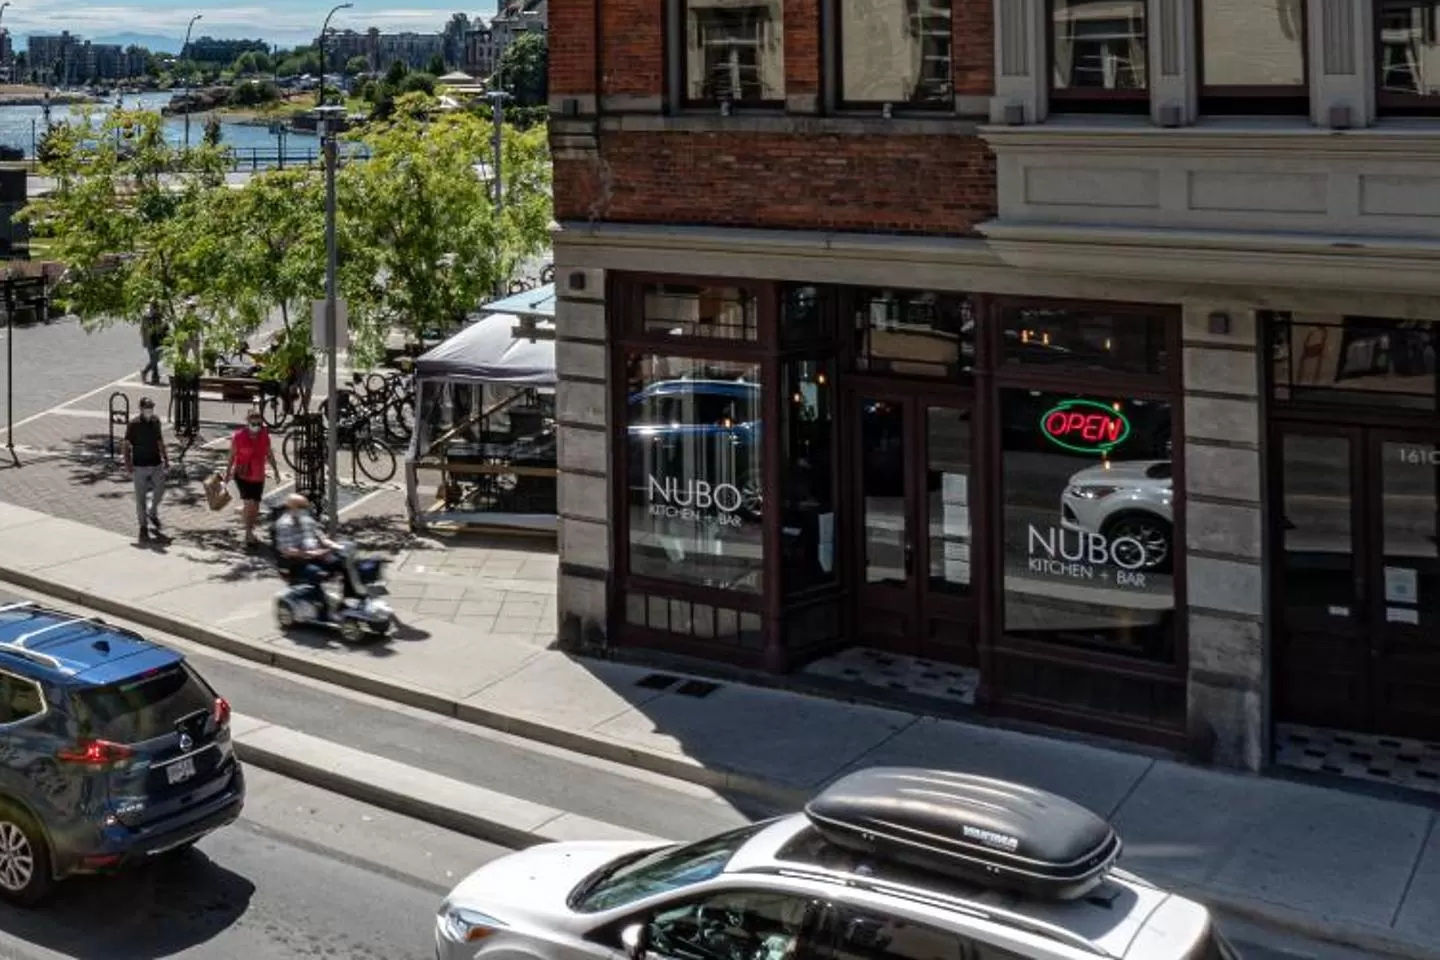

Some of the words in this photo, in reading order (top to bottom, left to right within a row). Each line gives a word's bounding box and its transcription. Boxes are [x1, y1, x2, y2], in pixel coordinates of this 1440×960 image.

[1046, 411, 1122, 441] OPEN
[648, 473, 742, 512] NUBO
[648, 503, 701, 521] KITCHEN
[719, 512, 742, 528] BAR
[1028, 524, 1146, 569] NUBO
[1028, 557, 1094, 579] KITCHEN
[1116, 570, 1146, 588] BAR
